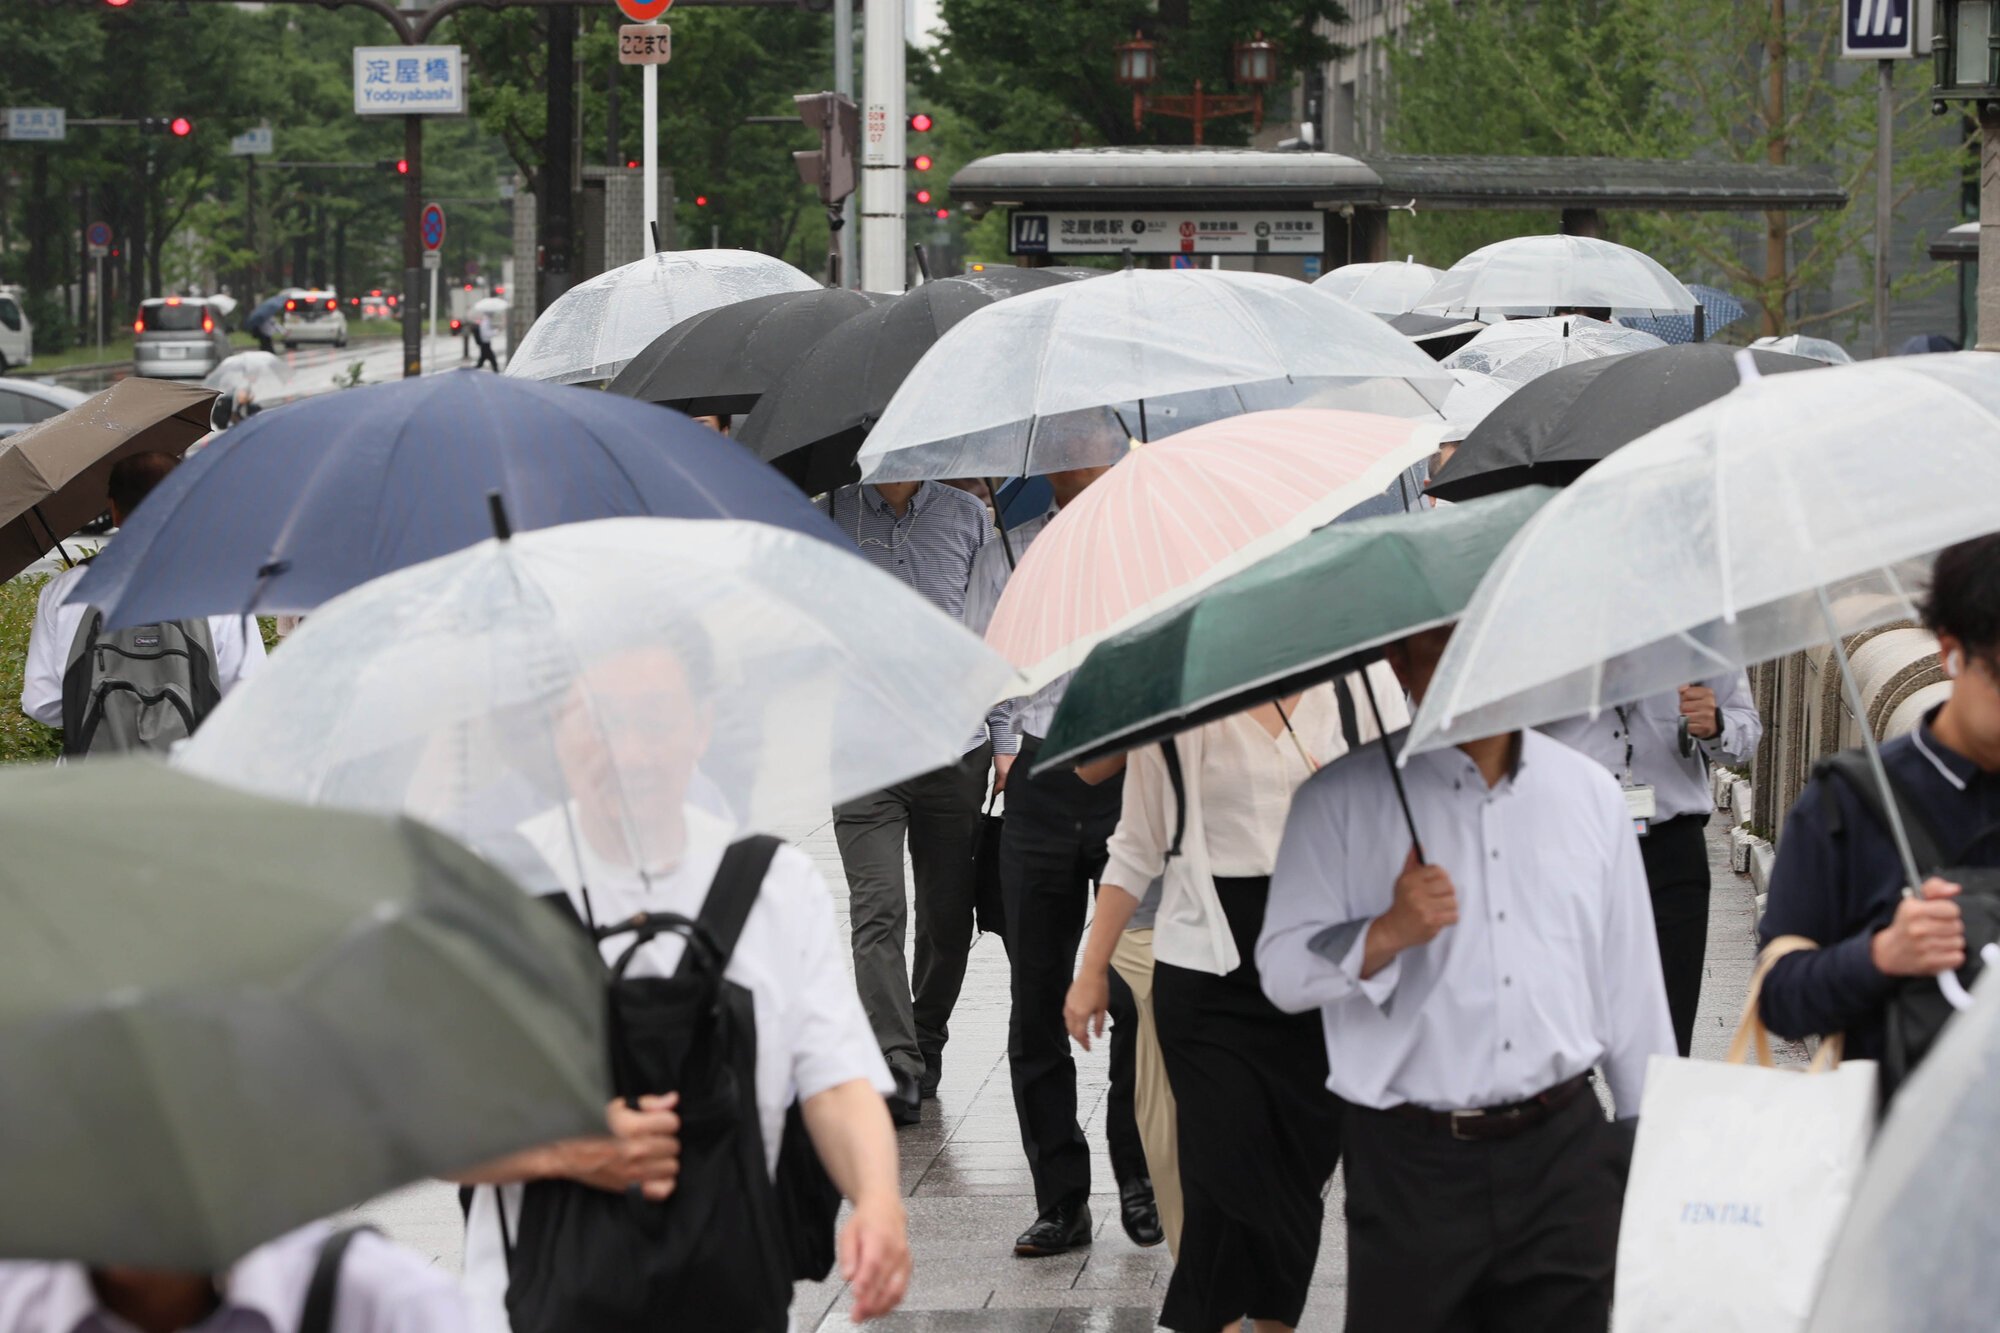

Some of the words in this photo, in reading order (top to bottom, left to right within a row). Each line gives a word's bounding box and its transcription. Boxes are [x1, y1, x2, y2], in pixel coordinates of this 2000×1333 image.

[622, 35, 667, 55] ここまで
[366, 58, 449, 84] 淀屋橋
[364, 86, 453, 103] Yodoyabashi
[1061, 219, 1124, 234] 淀屋橋駅
[1061, 237, 1109, 246] Yodoyabashi
[1111, 237, 1138, 245] Station
